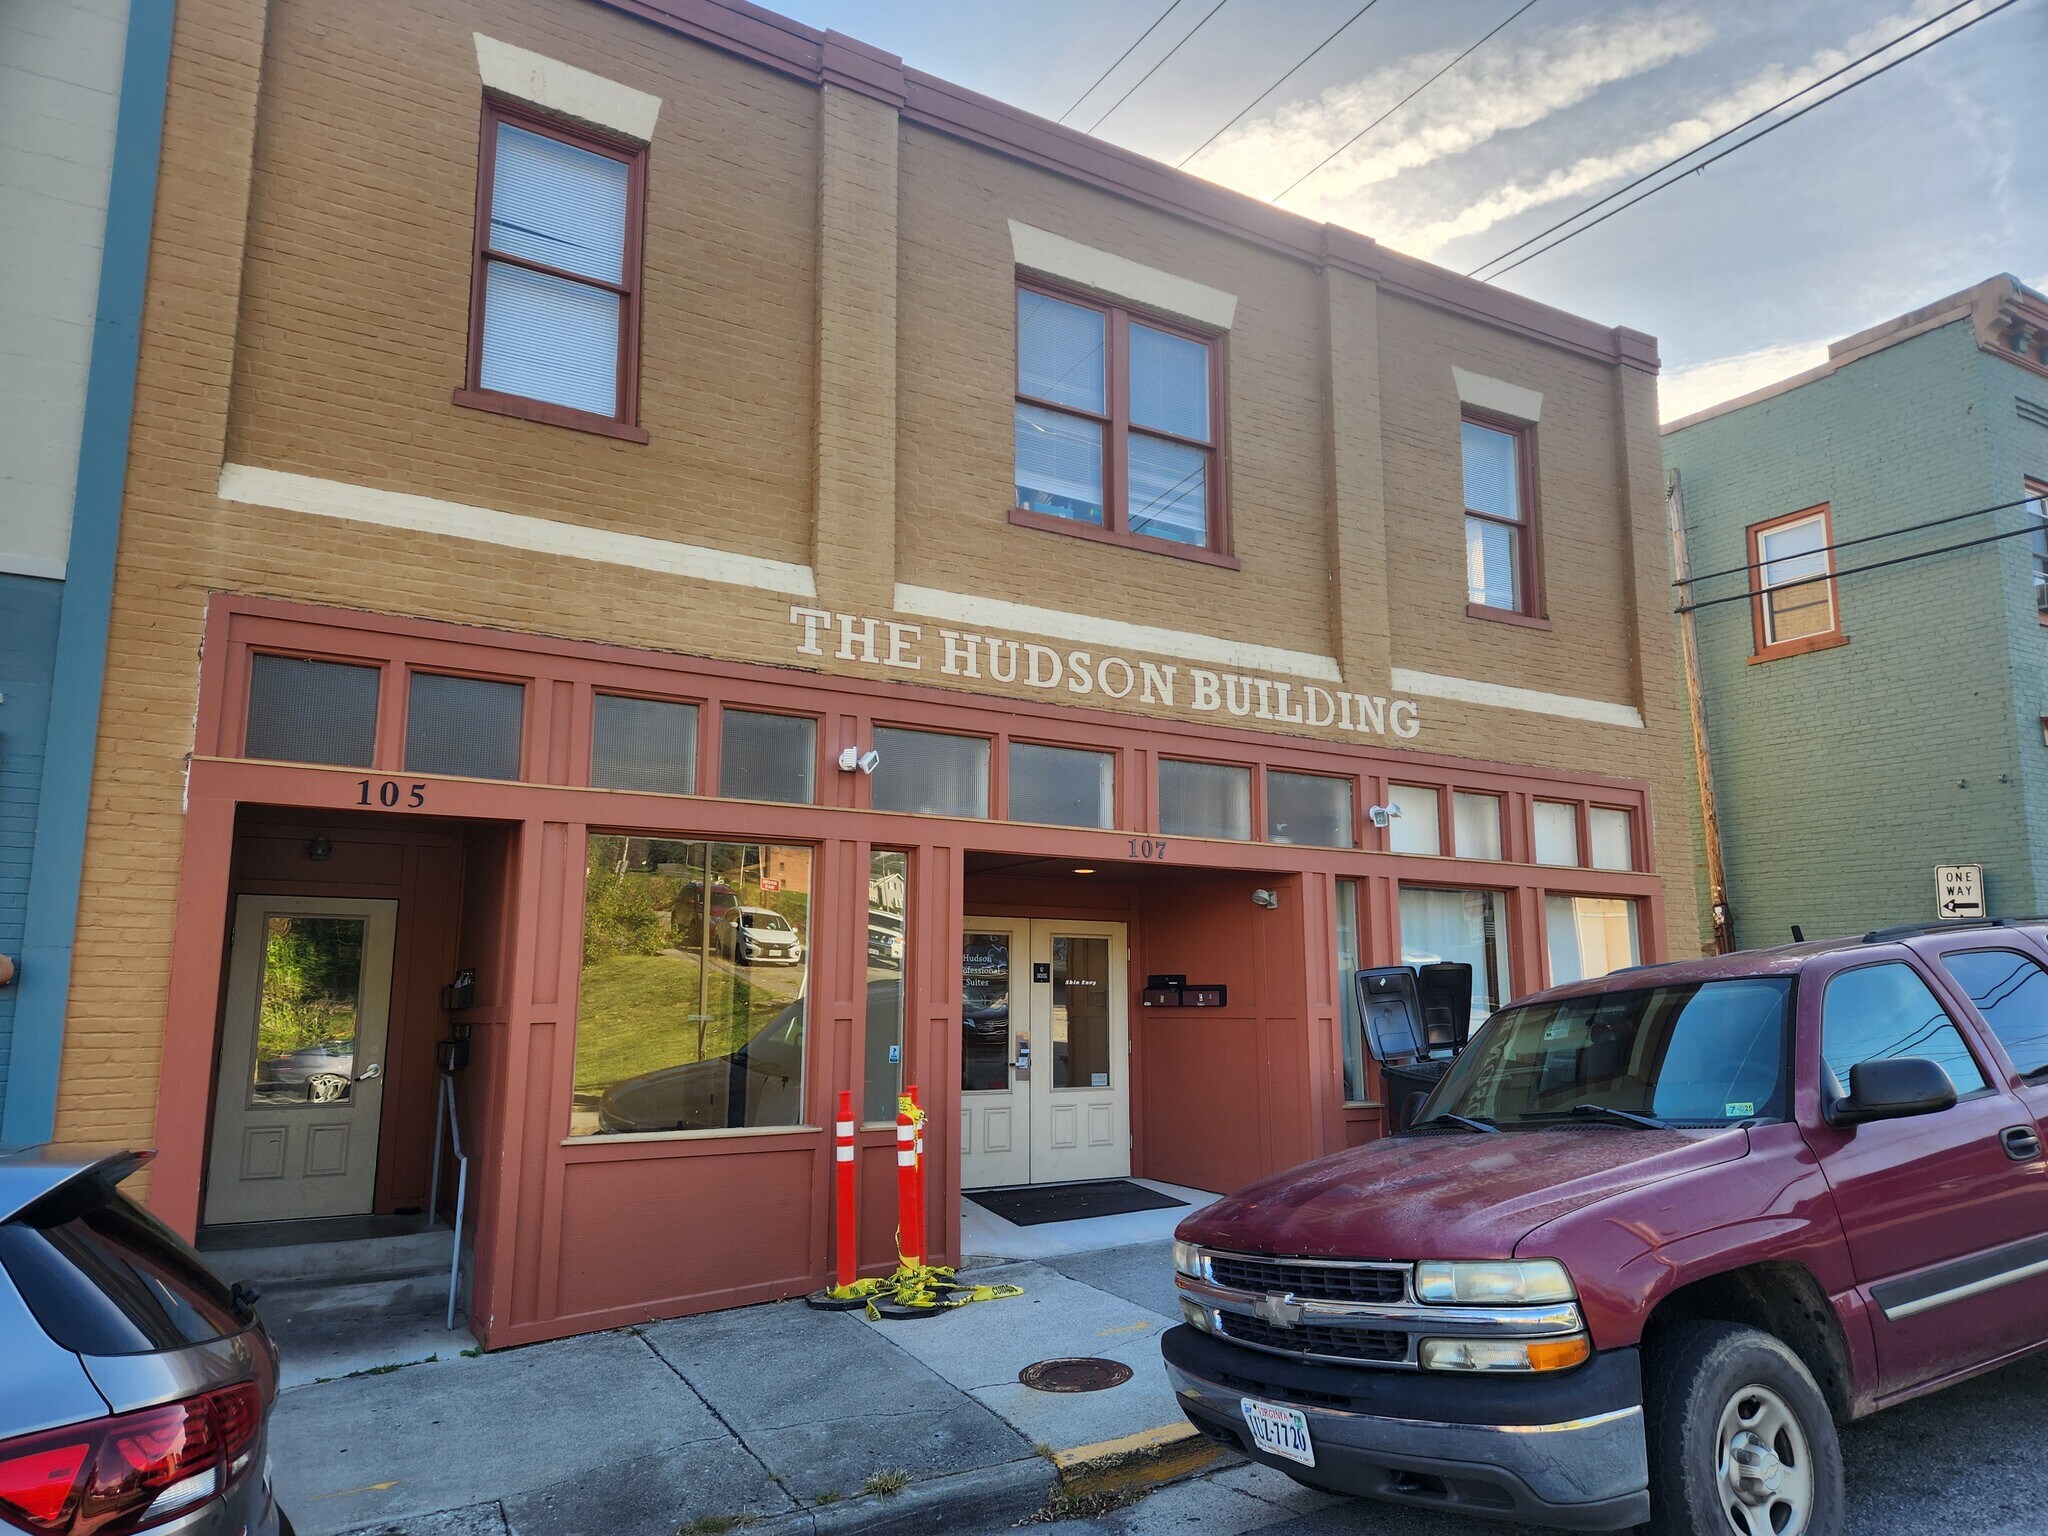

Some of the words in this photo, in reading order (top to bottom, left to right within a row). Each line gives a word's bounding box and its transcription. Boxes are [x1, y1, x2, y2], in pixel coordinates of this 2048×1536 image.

[790, 605, 922, 670] THE
[939, 628, 1178, 706] HUDSON
[1190, 667, 1421, 738] BUILDING
[356, 779, 426, 808] 105
[1127, 838, 1167, 860] 107
[1945, 871, 1973, 882] ONE
[1946, 885, 1972, 896] WAY
[963, 953, 992, 963] Hudson
[963, 965, 1000, 975] ofessional
[965, 977, 989, 987] Suites
[1258, 1406, 1289, 1421] VIRGINIA
